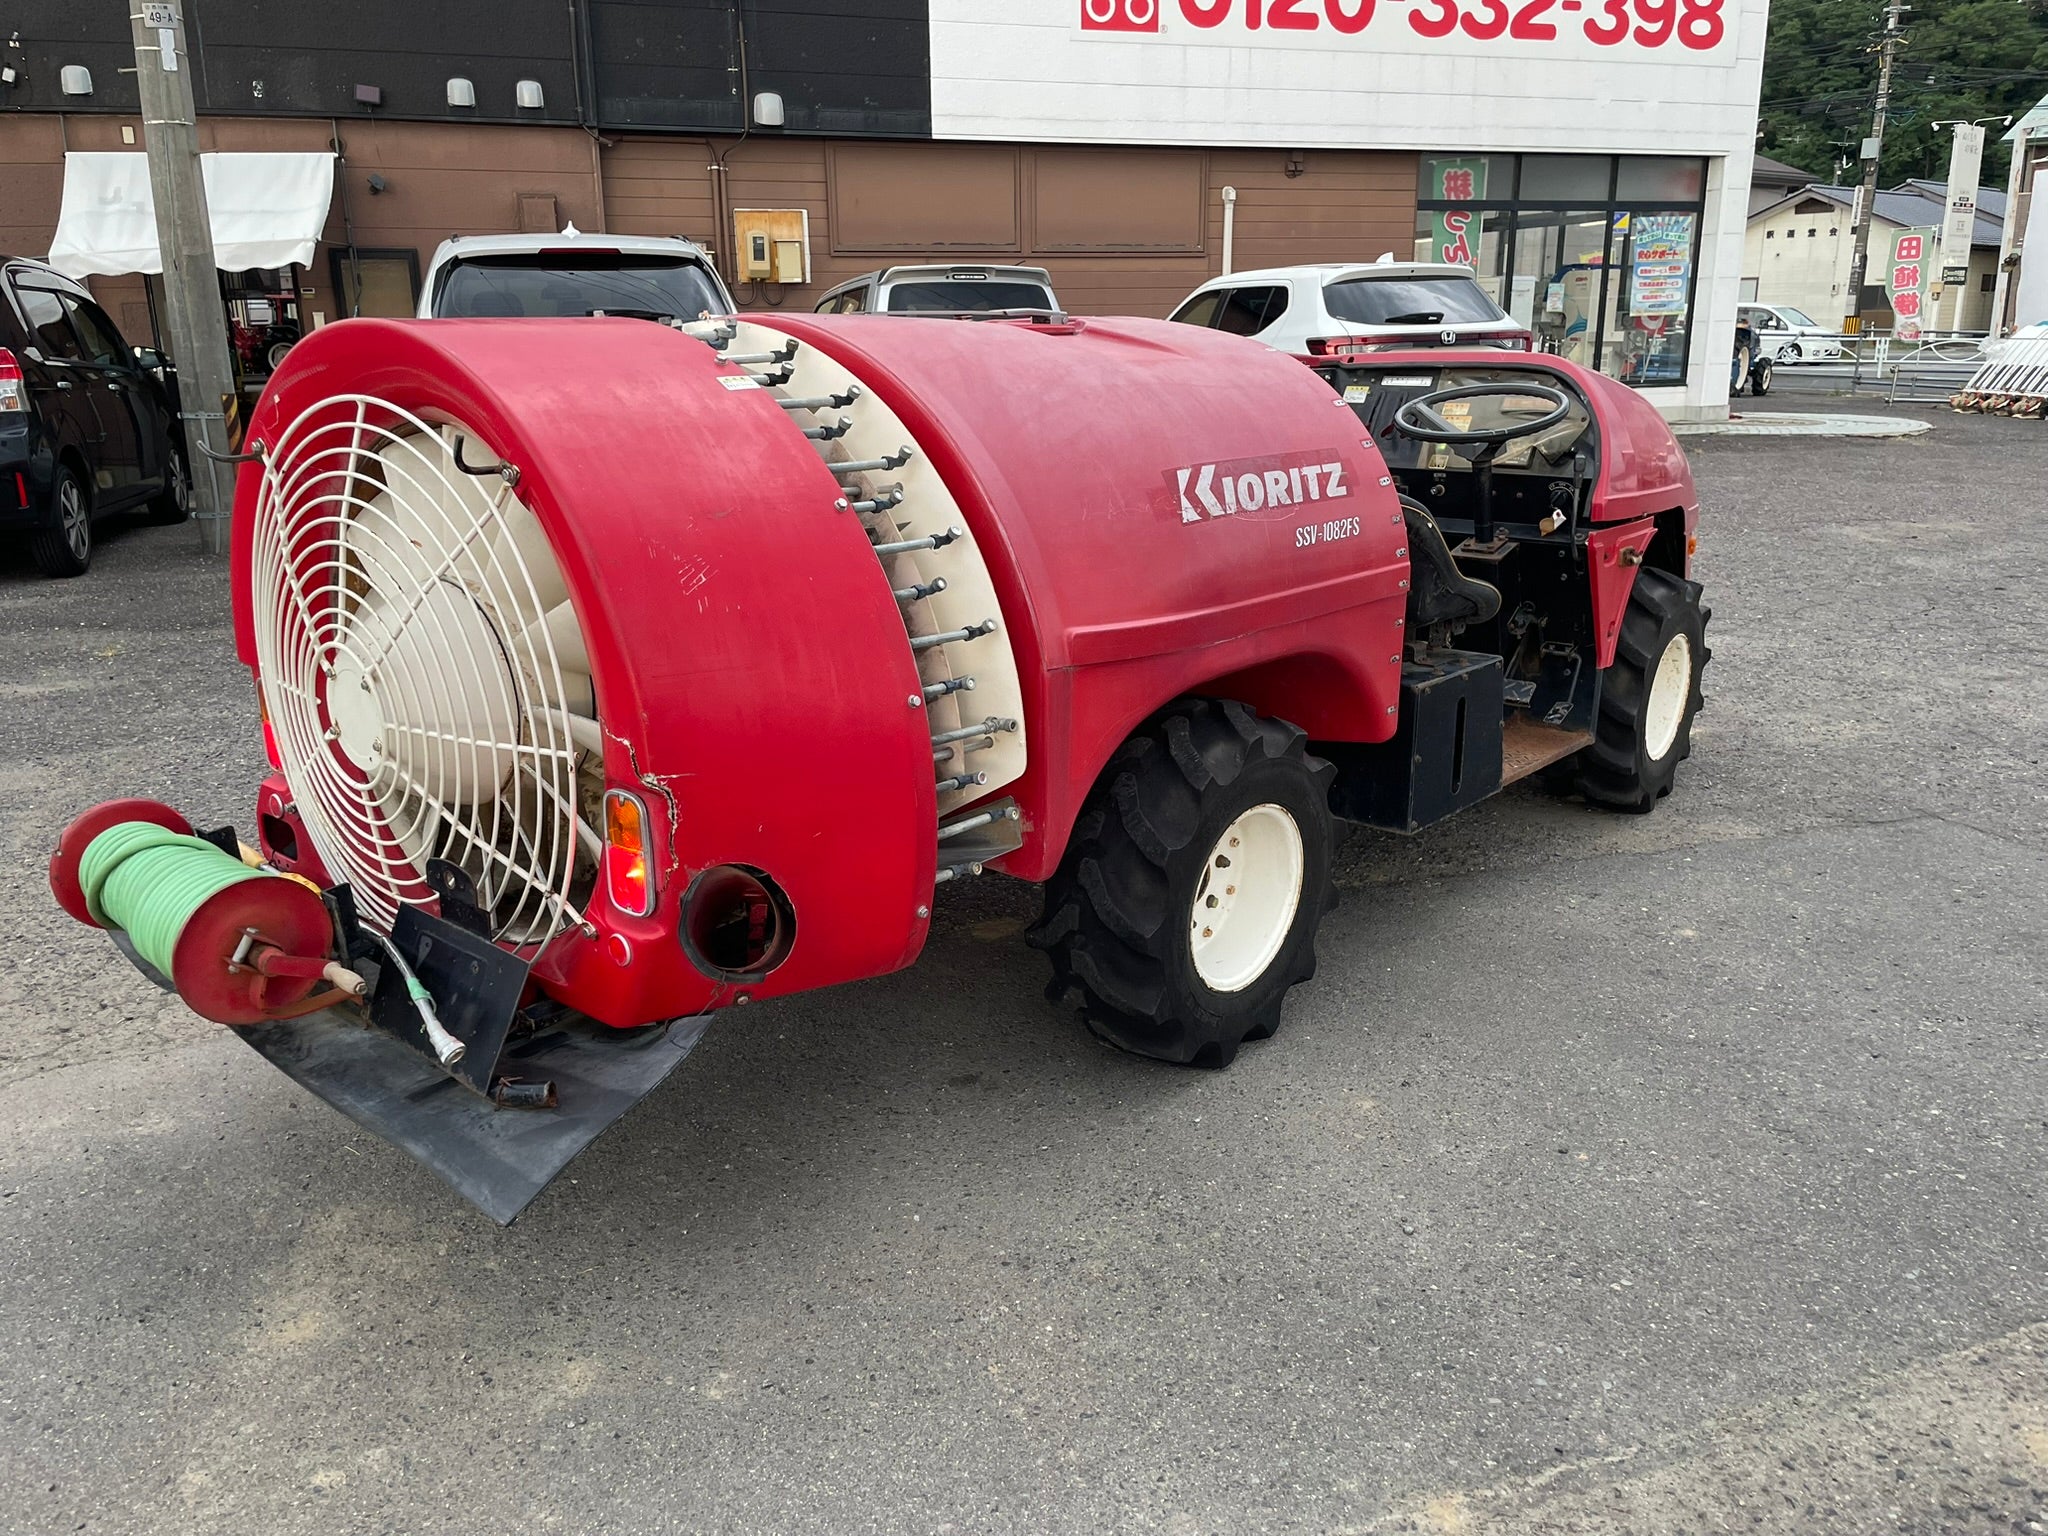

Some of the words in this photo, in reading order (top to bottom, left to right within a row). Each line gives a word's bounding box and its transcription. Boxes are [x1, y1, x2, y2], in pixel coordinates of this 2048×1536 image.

[150, 12, 173, 23] 49-A
[1177, 0, 1725, 50] 332-398
[1176, 462, 1348, 524] KIORITZ
[1295, 516, 1360, 548] SSV-1082FS
